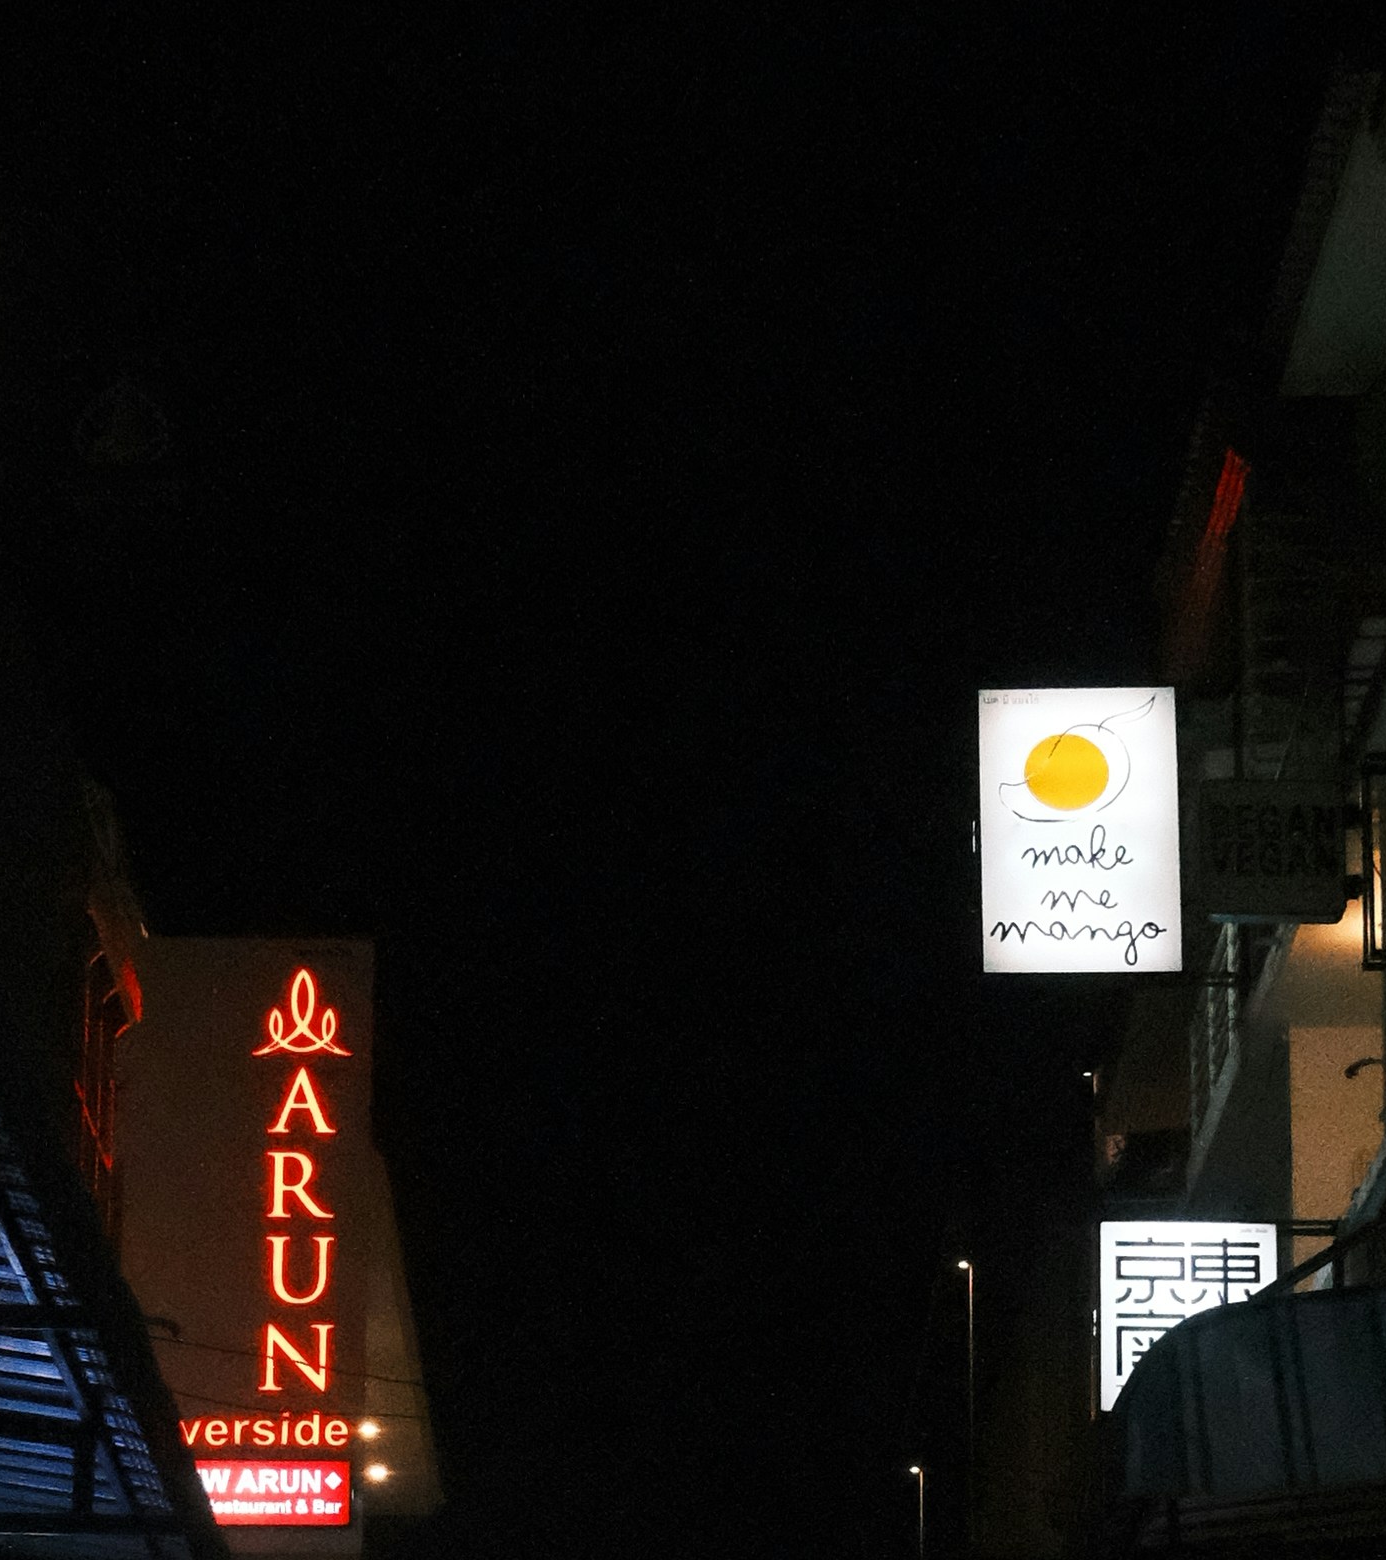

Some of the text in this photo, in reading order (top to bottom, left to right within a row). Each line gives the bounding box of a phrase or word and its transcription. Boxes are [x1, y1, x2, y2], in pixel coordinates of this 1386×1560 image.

[1021, 824, 1134, 870] make
[1040, 882, 1119, 913] me
[990, 919, 1167, 966] mango
[257, 1065, 338, 1395] ARUN
[178, 1410, 350, 1447] verside
[235, 1468, 322, 1495] ARUN
[211, 1499, 293, 1515] estaurant
[313, 1499, 343, 1515] Bar
